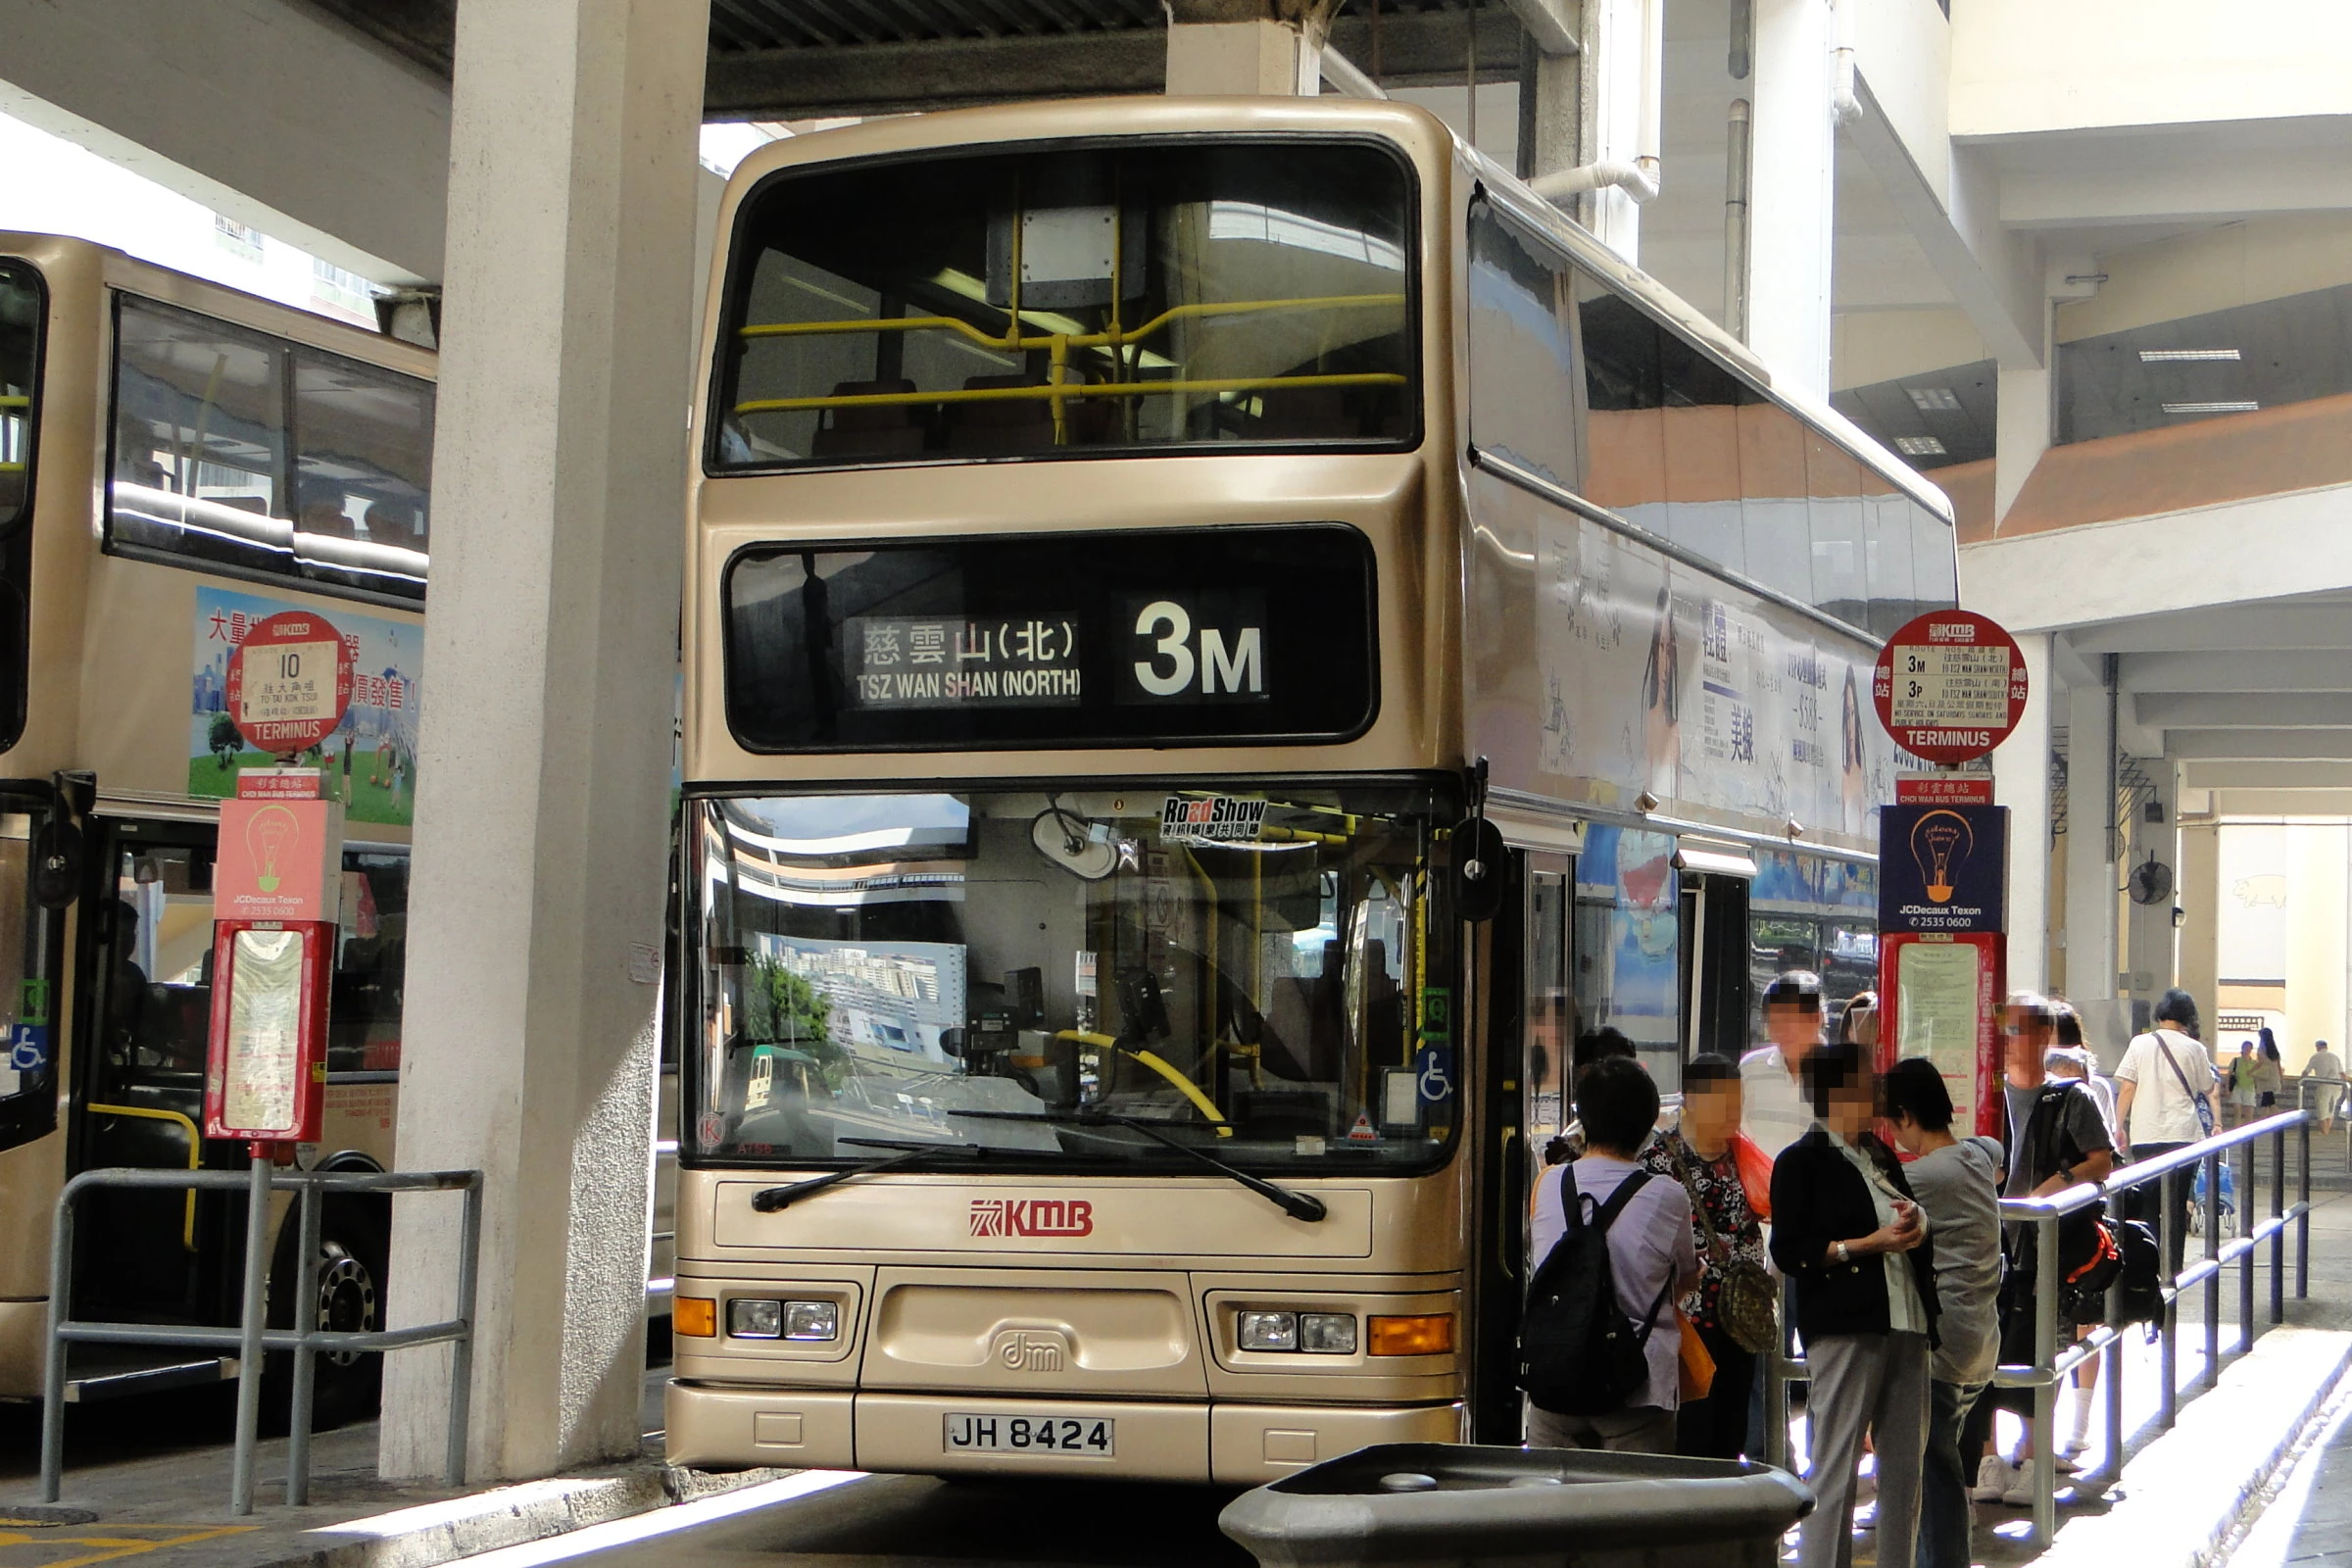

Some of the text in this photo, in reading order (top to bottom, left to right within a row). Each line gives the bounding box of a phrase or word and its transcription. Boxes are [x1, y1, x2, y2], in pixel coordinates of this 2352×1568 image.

[1941, 623, 1976, 637] KMB
[862, 620, 1074, 666] 慈雲山(北)
[1134, 600, 1263, 696] 3M
[280, 654, 300, 679] 10
[1907, 655, 1926, 673] 3M
[856, 668, 1081, 700] TSZ WAN SHAN (NORTH)
[1874, 664, 1890, 698] 總站
[1908, 680, 1923, 698] 3P
[2010, 666, 2027, 700] 總站
[284, 693, 299, 703] KOK
[254, 719, 321, 741] TERMINUS
[1906, 730, 1990, 747] TERMINUS
[1163, 797, 1267, 824] RoadShow
[233, 895, 304, 906] JCDecaux Texon
[1899, 905, 1982, 915] JCDecaux Texon
[1921, 917, 1972, 927] 2535 0600
[1005, 1200, 1094, 1238] KMB
[953, 1417, 1108, 1451] JH 8424
